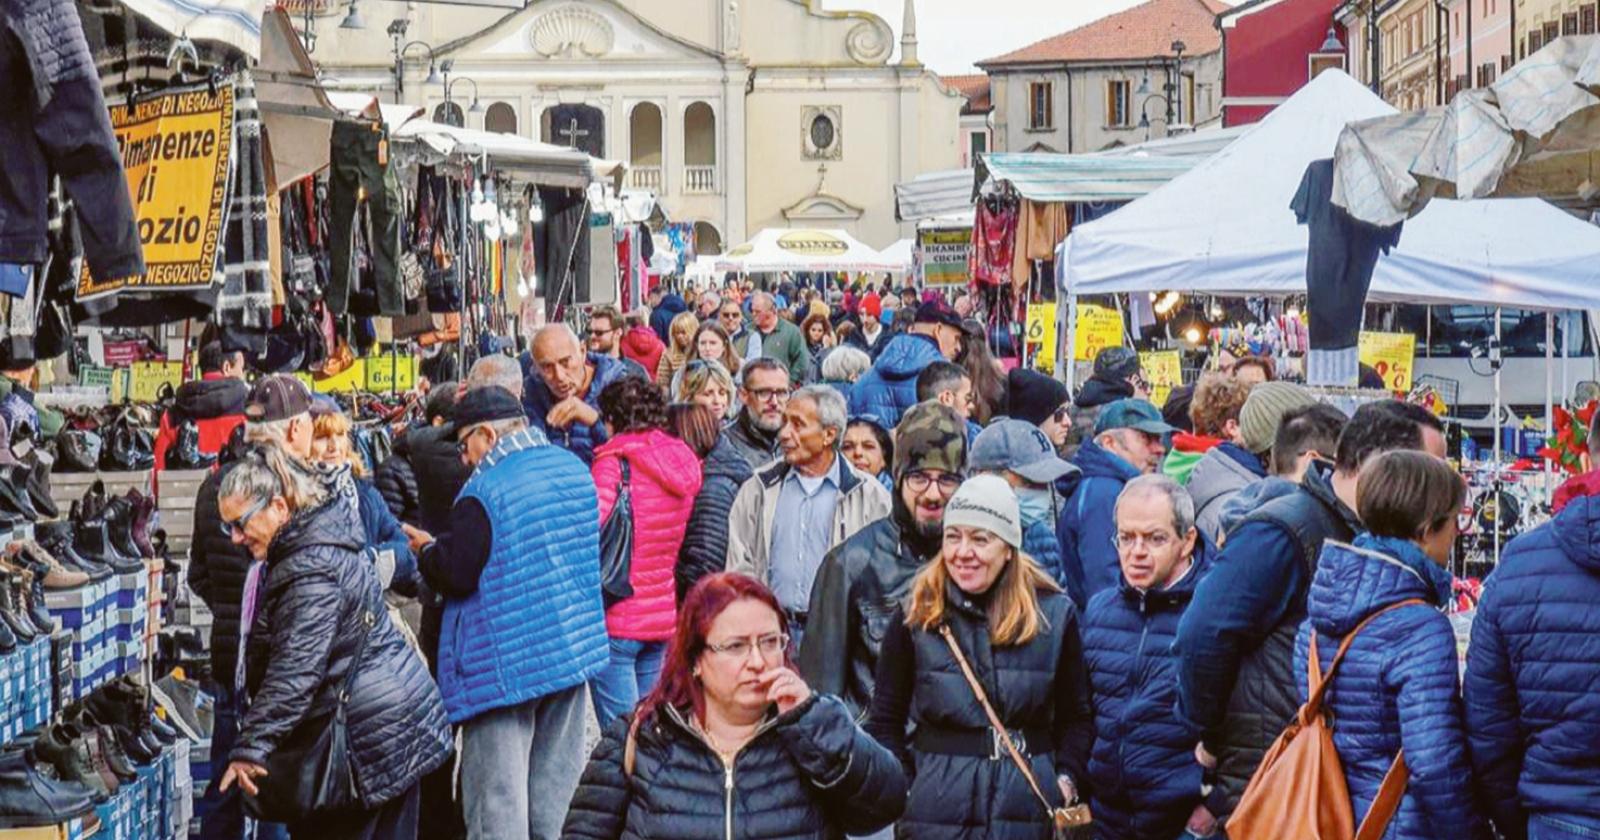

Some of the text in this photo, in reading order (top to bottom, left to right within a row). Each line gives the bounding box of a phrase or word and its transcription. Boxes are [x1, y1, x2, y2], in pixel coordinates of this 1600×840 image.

[161, 95, 176, 115] DI
[176, 88, 223, 114] NEGOZIO
[137, 166, 157, 204] di
[200, 86, 232, 281] RIMANENZE DI NEGOZIO
[138, 206, 200, 245] ozio
[146, 263, 200, 284] NEGOZIO
[1029, 319, 1043, 339] 6
